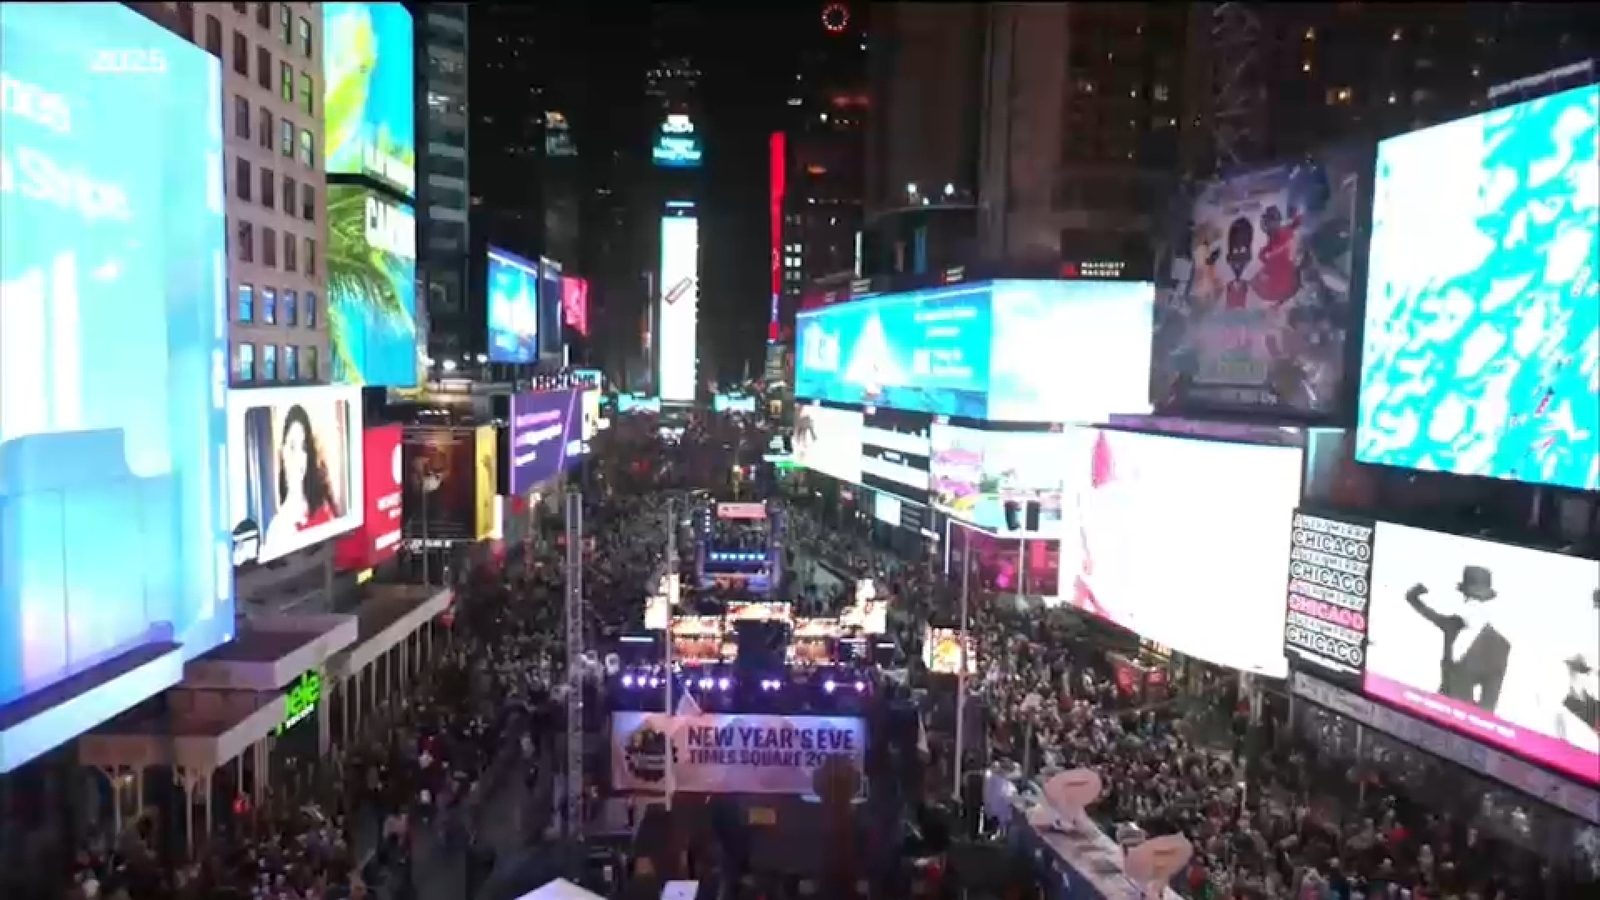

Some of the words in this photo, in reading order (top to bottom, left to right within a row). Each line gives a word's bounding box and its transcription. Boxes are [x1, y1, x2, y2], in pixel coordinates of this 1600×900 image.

[687, 726, 735, 747] NEW
[738, 727, 814, 749] YEAR'S
[817, 729, 855, 750] EVE
[690, 750, 737, 765] TIMES
[740, 750, 800, 767] SQUARE
